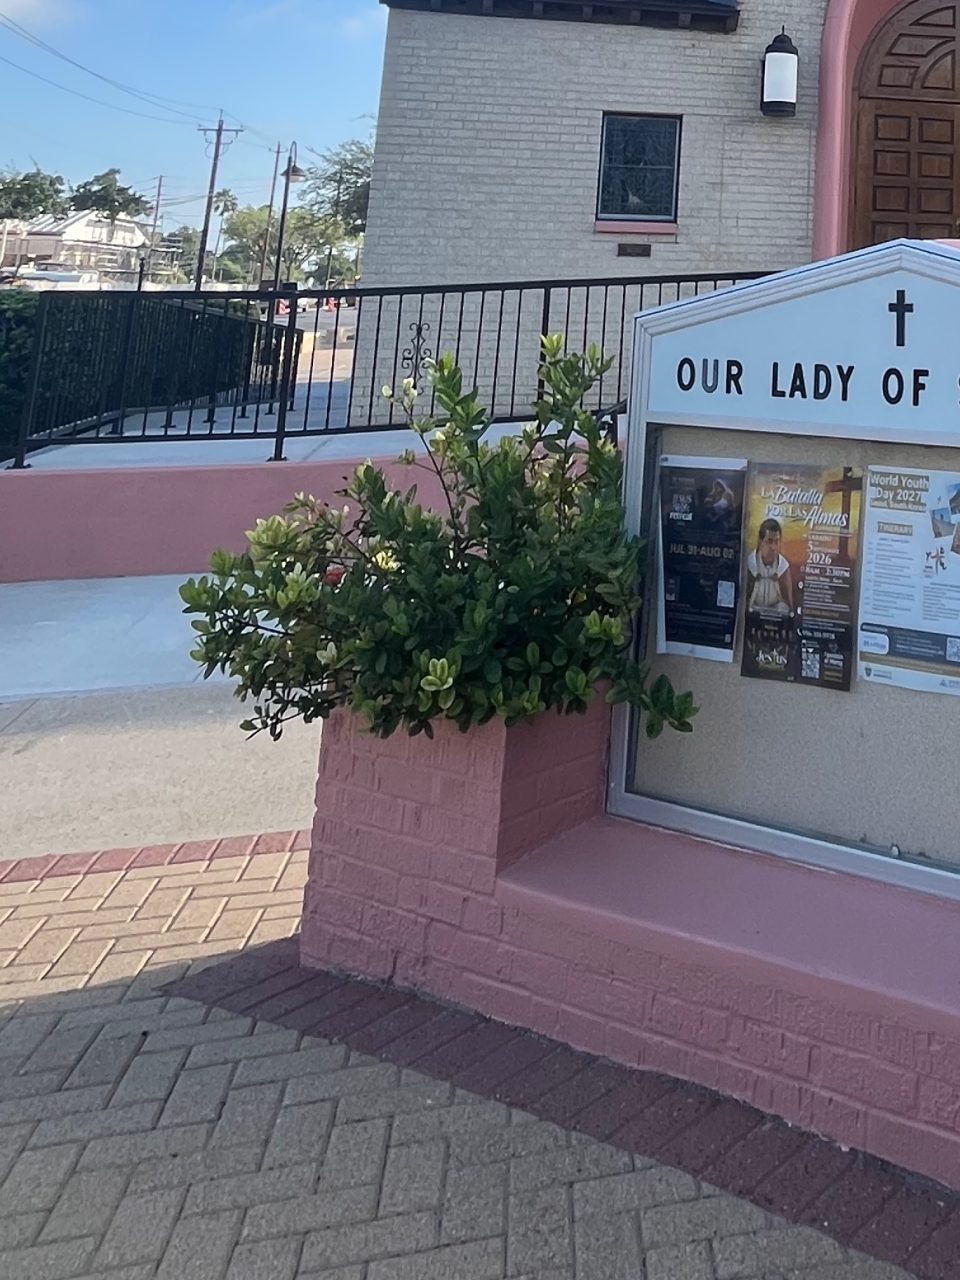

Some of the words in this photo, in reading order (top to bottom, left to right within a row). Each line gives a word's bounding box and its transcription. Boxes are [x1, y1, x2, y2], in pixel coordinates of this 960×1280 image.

[677, 357, 743, 395] OUR
[771, 361, 855, 401] LADY
[882, 367, 929, 406] OF
[870, 474, 899, 487] World
[901, 477, 929, 489] Youth
[876, 487, 894, 500] Day
[897, 489, 920, 502] 2027
[804, 506, 848, 528] Almas
[670, 543, 685, 554] JUL
[806, 552, 832, 565] 2026
